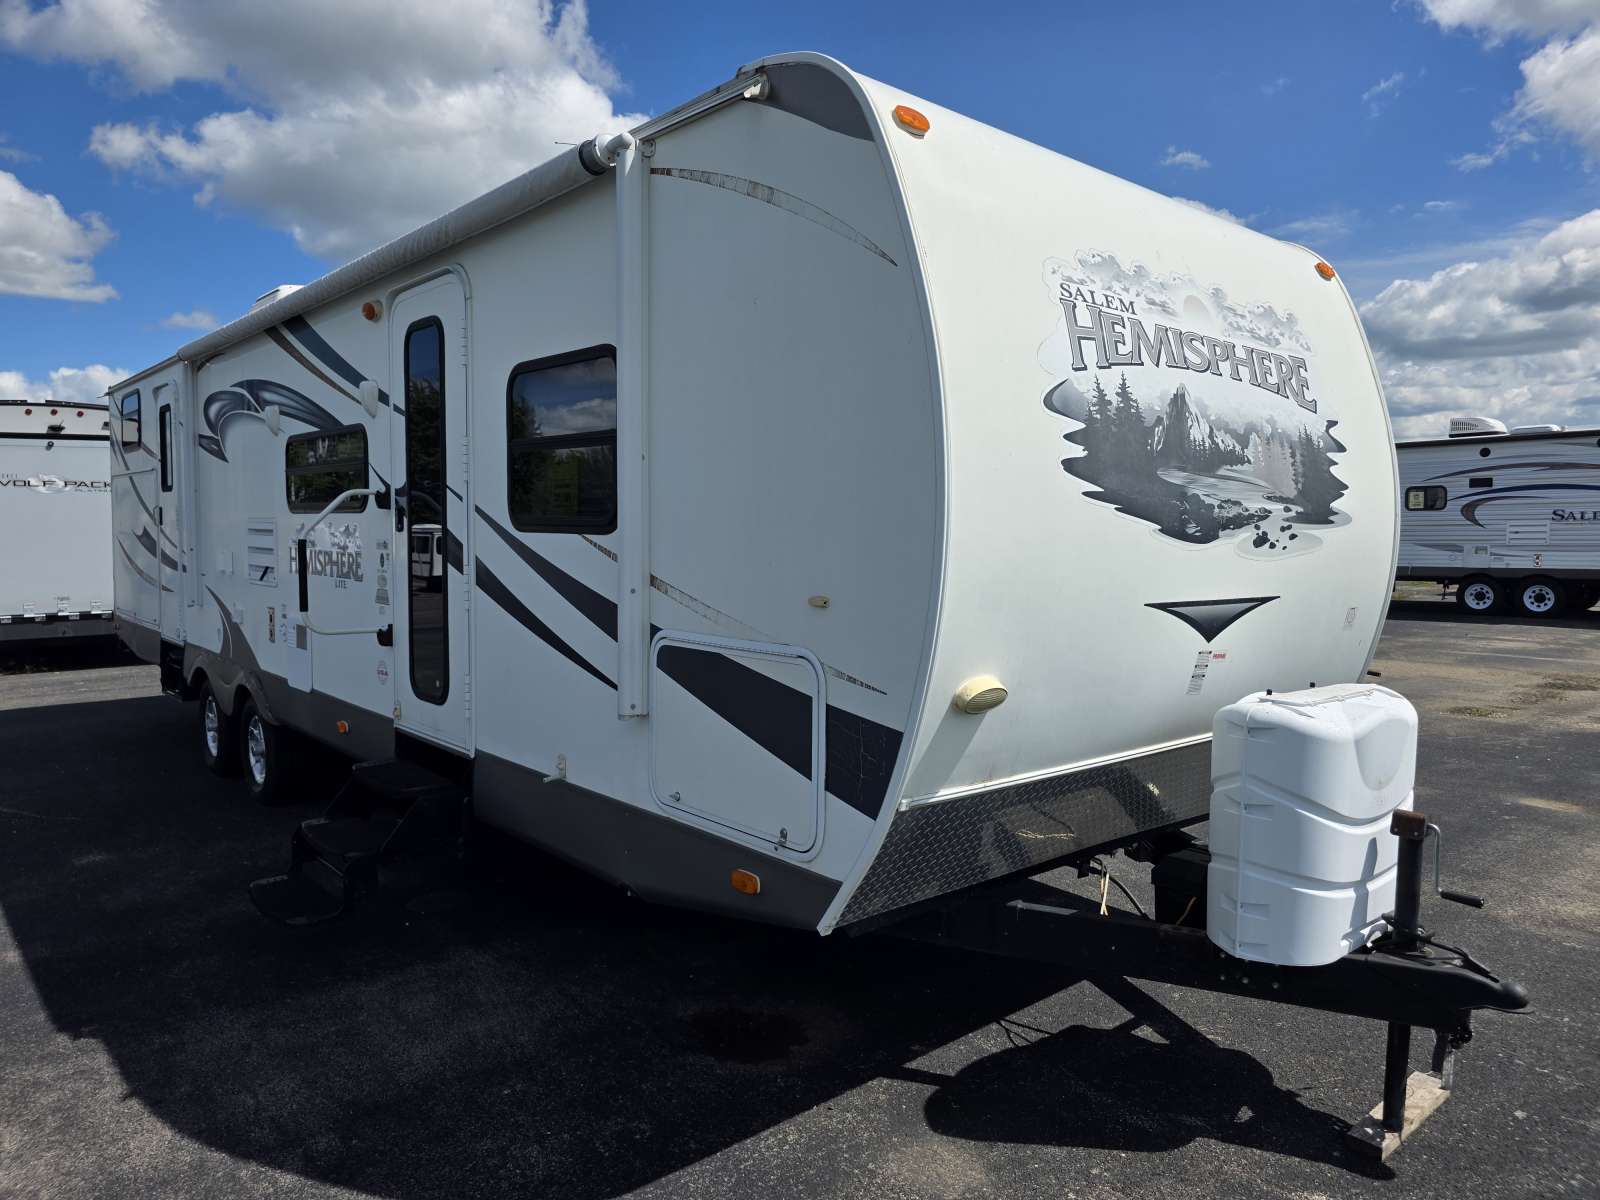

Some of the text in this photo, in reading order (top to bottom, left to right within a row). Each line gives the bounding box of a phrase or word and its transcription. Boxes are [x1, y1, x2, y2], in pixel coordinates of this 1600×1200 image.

[1059, 282, 1138, 316] SALEM
[1059, 297, 1318, 414] HEMISPHERE
[289, 546, 364, 583] HMISPHERE
